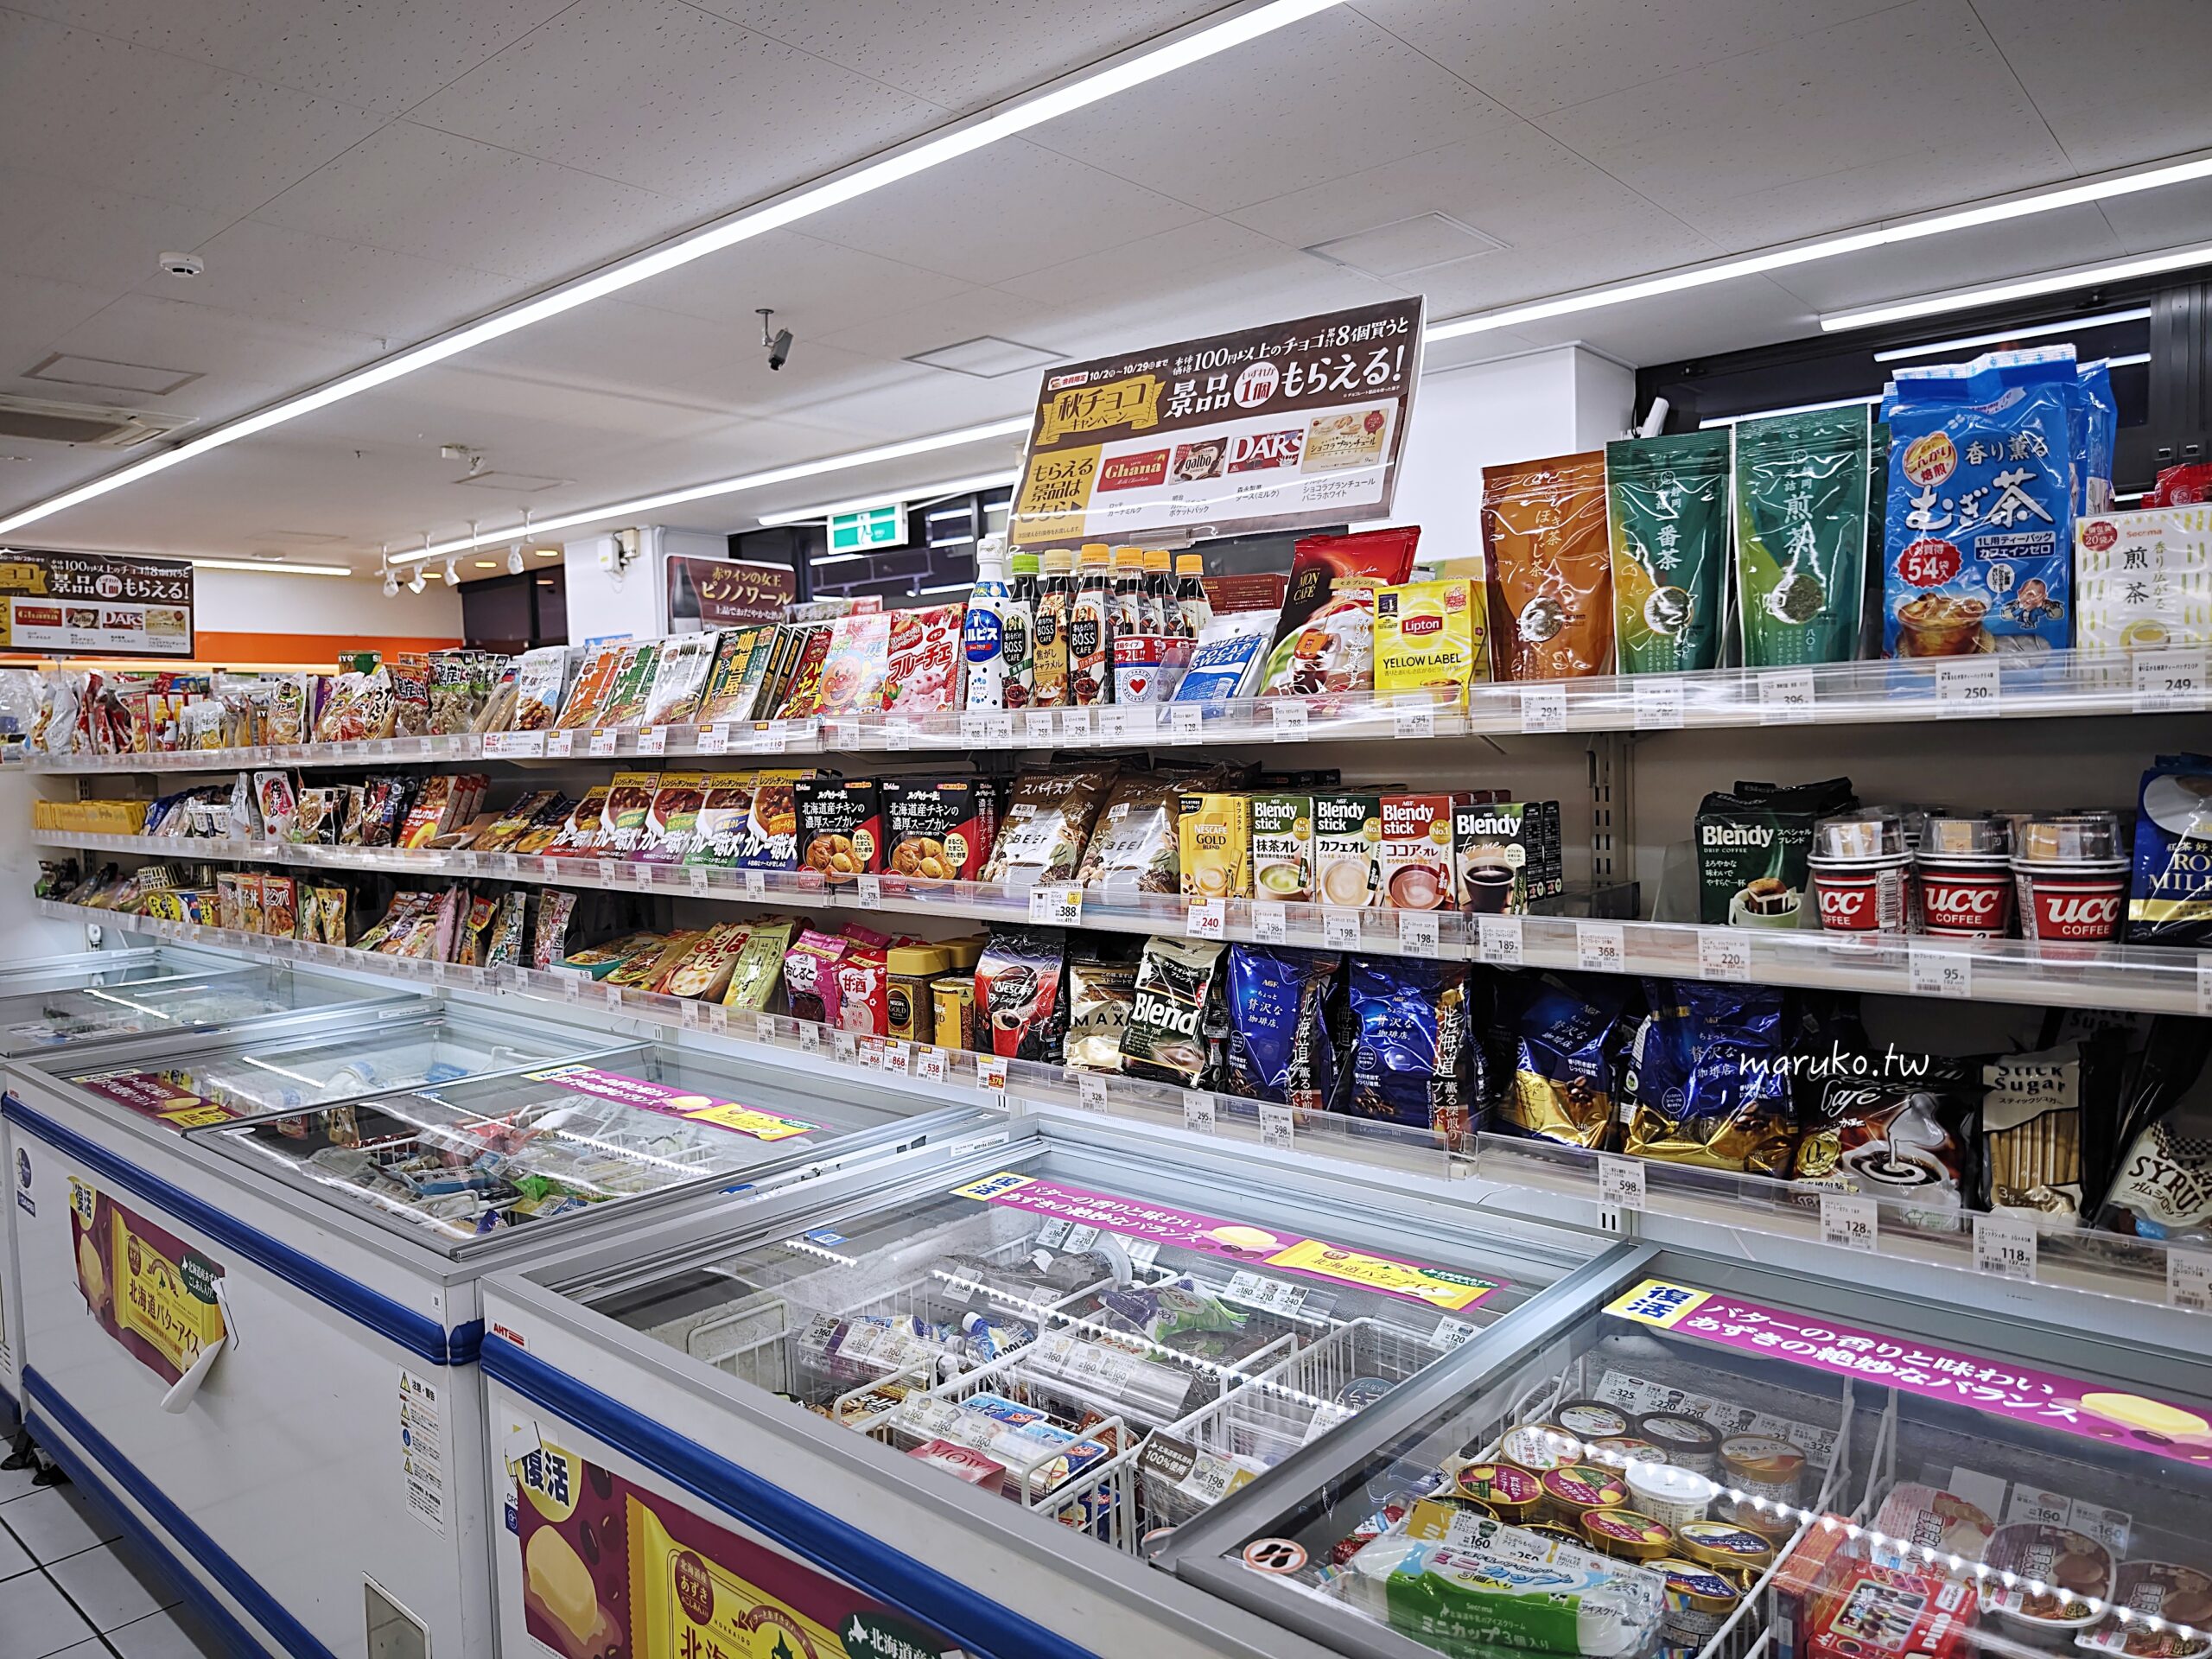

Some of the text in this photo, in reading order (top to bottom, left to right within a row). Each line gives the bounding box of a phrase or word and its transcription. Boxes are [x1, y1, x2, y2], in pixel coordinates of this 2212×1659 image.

[1163, 372, 1230, 418] 景品
[1239, 381, 1271, 403] 1個
[1058, 383, 1147, 421] 秋チョコ
[1073, 412, 1128, 430] キャンペーン
[1230, 432, 1304, 464] DARS
[1033, 458, 1093, 482] もらえる
[1185, 454, 1211, 471] galbo
[1105, 461, 1161, 480] Ghana
[1031, 480, 1083, 501] 景品は
[1303, 478, 1376, 493] ショコラブランチュール
[1301, 490, 1347, 501] バニラホワイト
[1905, 467, 2054, 530] むぎ茶
[1784, 493, 1813, 554] 煎茶
[1978, 533, 2053, 546] 1L用ティーバッグ
[1979, 545, 2050, 558] カフェインゼロ
[712, 566, 781, 588] 赤ワインの女王
[1298, 573, 1319, 588] MON
[2123, 546, 2149, 604] 煎茶
[52, 574, 95, 594] 景品
[701, 581, 793, 607] ピノノワール
[105, 612, 143, 626] DARS
[1406, 620, 1440, 632] Lipton
[1037, 625, 1054, 636] BOSS
[1071, 632, 1095, 645] BOSS
[1004, 641, 1023, 653] BOSS
[889, 642, 953, 683] フルーチェ
[1033, 661, 1064, 671] キャラメル
[1192, 653, 1244, 670] SWEAT
[1382, 653, 1462, 669] YELLOW LABEL
[802, 803, 865, 814] 北海道産チキンの
[889, 804, 959, 817] 北海道産チキンの
[1255, 802, 1298, 821] Blendy
[1318, 802, 1366, 821] Blendy
[1382, 804, 1434, 823] Blendy
[805, 817, 863, 828] 濃厚スープカレー
[893, 817, 957, 830] 濃厚スープカレー
[1255, 818, 1281, 830] stick
[1318, 818, 1347, 831] stick
[1383, 821, 1414, 835] stick
[1457, 814, 1522, 836] Blendy
[1014, 834, 1048, 844] BEEF
[1196, 834, 1226, 845] GOLD
[1702, 824, 1773, 849] Blendy
[1256, 840, 1300, 853] 抹茶オレ
[1319, 841, 1370, 854] カフェオレ
[1705, 868, 1734, 877] 味わいで
[1706, 878, 1746, 887] やすらぐ一杯
[1060, 906, 1077, 917] 388
[1936, 913, 1982, 925] COFFEE
[1202, 918, 1219, 928] 240
[2062, 925, 2109, 935] COFFEE
[1340, 928, 1353, 938] 198
[1416, 933, 1430, 943] 198
[1498, 940, 1514, 950] 189
[1598, 946, 1615, 957] 368
[842, 975, 868, 994] 甘酒
[1132, 993, 1200, 1035] Blend
[1248, 999, 1283, 1015] 贅沢な
[1293, 994, 1313, 1064] 北海道
[1377, 1014, 1414, 1029] 贅沢な
[1433, 1007, 1458, 1078] 北海道
[892, 1057, 906, 1067] 868
[1689, 1046, 1738, 1063] 贅沢な
[927, 1063, 940, 1073] 538
[1994, 1077, 2066, 1095] Sugar
[1432, 1081, 1443, 1127] ブレンド
[1999, 1096, 2065, 1106] スティックシュガー
[1445, 1081, 1459, 1141] 薫る深煎り
[1274, 1125, 1287, 1135] 598
[1020, 1185, 1203, 1228] バターの香りと味わい
[2130, 1181, 2196, 1218] ガムシロップ
[1001, 1192, 1204, 1243] あずきの絶妙なバランス
[1628, 1286, 1694, 1319] 復活
[130, 1279, 200, 1359] 北海道バターアイス
[493, 1323, 509, 1336] AHT
[818, 1326, 831, 1337] 160
[1450, 1333, 1465, 1344] 120
[1702, 1305, 2055, 1395] バターの香りと味わい
[1687, 1315, 2080, 1423] あずきの絶妙なバランス
[1616, 1389, 1636, 1400] 325
[1656, 1400, 1676, 1411] 220
[1683, 1408, 1704, 1419] 220
[1727, 1421, 1748, 1432] 220
[977, 1437, 991, 1447] 160
[1809, 1441, 1831, 1453] 325
[925, 1444, 991, 1470] MOW
[1146, 1451, 1187, 1475] 100%使用
[1209, 1475, 1224, 1488] 198
[2037, 1507, 2060, 1521] 160
[1471, 1535, 1490, 1548] 160
[680, 1559, 708, 1585] 北海道産
[1430, 1551, 1573, 1585] ミニカップ
[1457, 1571, 1514, 1590] 3個入り
[680, 1575, 708, 1604] あずき
[714, 1619, 750, 1646] HOKKAIDO
[1922, 1613, 1951, 1649] pino
